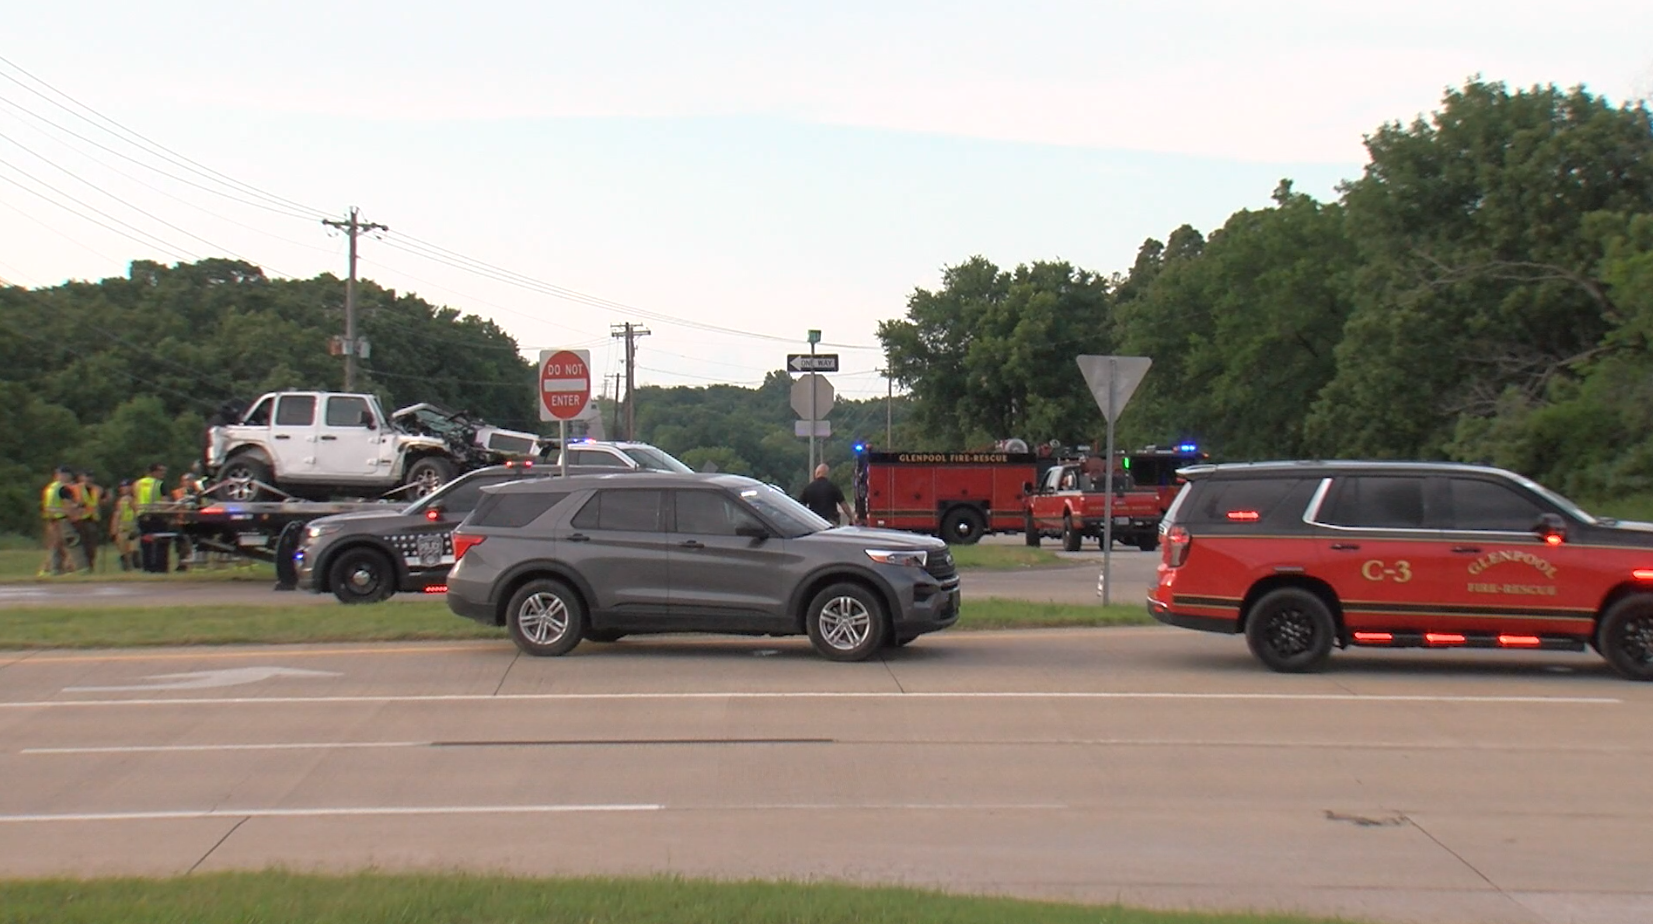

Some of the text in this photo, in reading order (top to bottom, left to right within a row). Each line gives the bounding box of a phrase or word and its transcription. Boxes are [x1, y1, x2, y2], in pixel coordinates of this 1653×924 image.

[548, 363, 583, 375] DO NOT
[817, 359, 833, 367] WAY
[551, 394, 580, 407] ENTER
[899, 453, 1008, 463] GLENPOOL FIRE-RESCUE
[1361, 559, 1413, 583] C-3
[1467, 550, 1558, 579] GLENPOOL
[1467, 582, 1557, 596] FIRE-RESCUE
